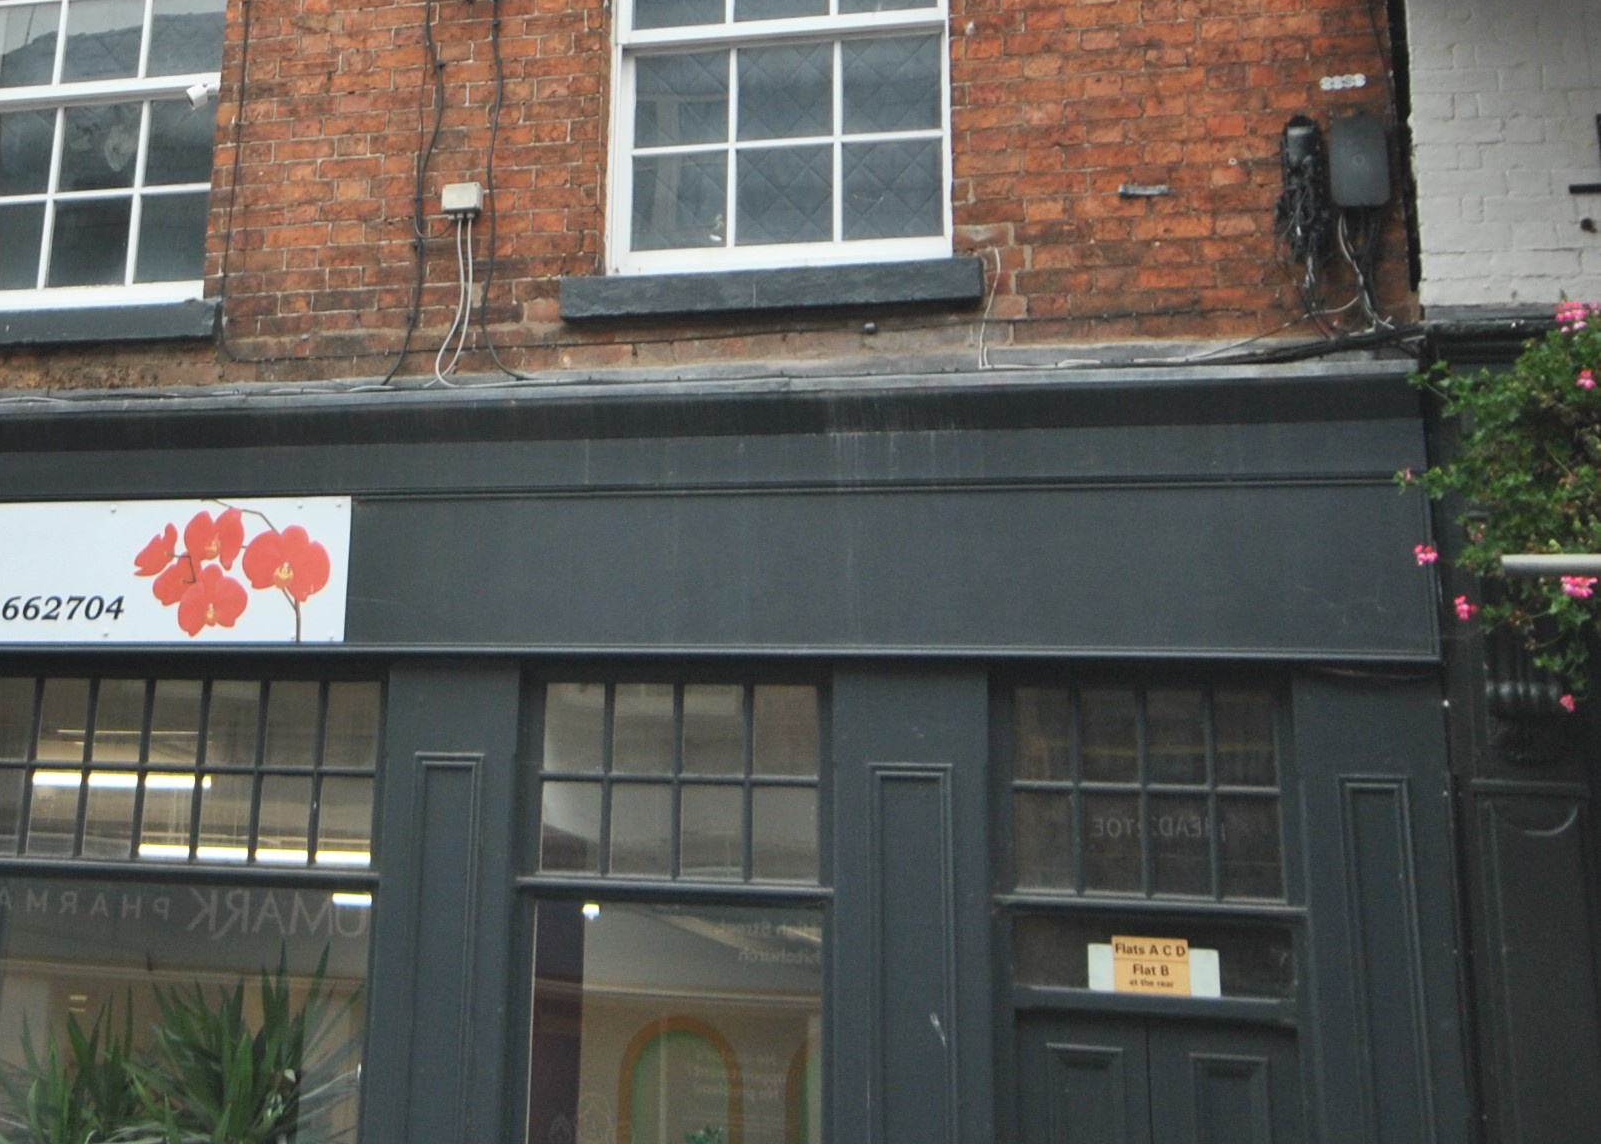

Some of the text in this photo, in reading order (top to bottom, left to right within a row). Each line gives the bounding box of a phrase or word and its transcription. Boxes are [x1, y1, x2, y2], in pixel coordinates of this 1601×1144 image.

[1, 595, 125, 622] 662704
[1115, 943, 1186, 957] Flats A C D
[1133, 963, 1170, 977] Flat B
[1141, 978, 1155, 987] the
